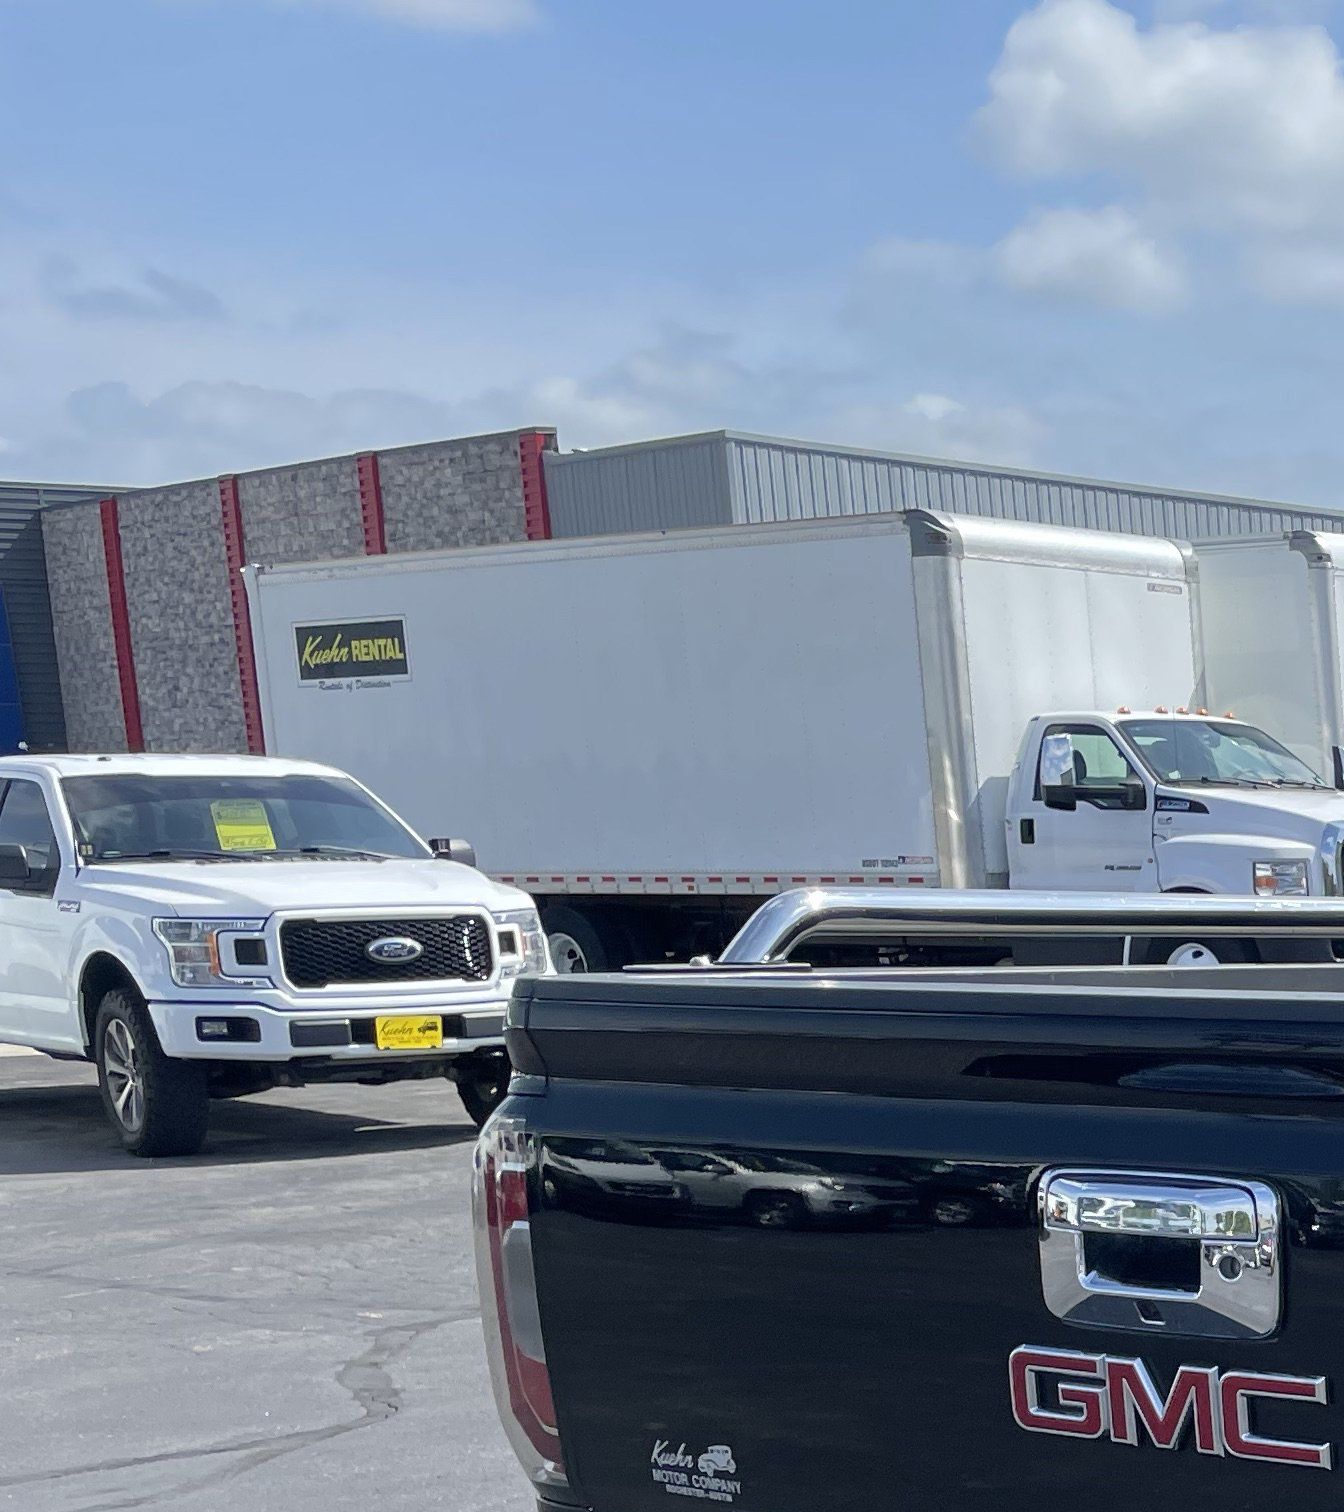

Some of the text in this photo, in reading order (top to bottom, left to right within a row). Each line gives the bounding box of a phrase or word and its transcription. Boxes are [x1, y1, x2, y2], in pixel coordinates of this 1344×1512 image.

[301, 633, 405, 669] Kuehn RENTAL
[1008, 1344, 1333, 1471] GMC
[650, 1439, 694, 1469] Kuehn
[652, 1468, 742, 1495] MOTOR COMPANY
